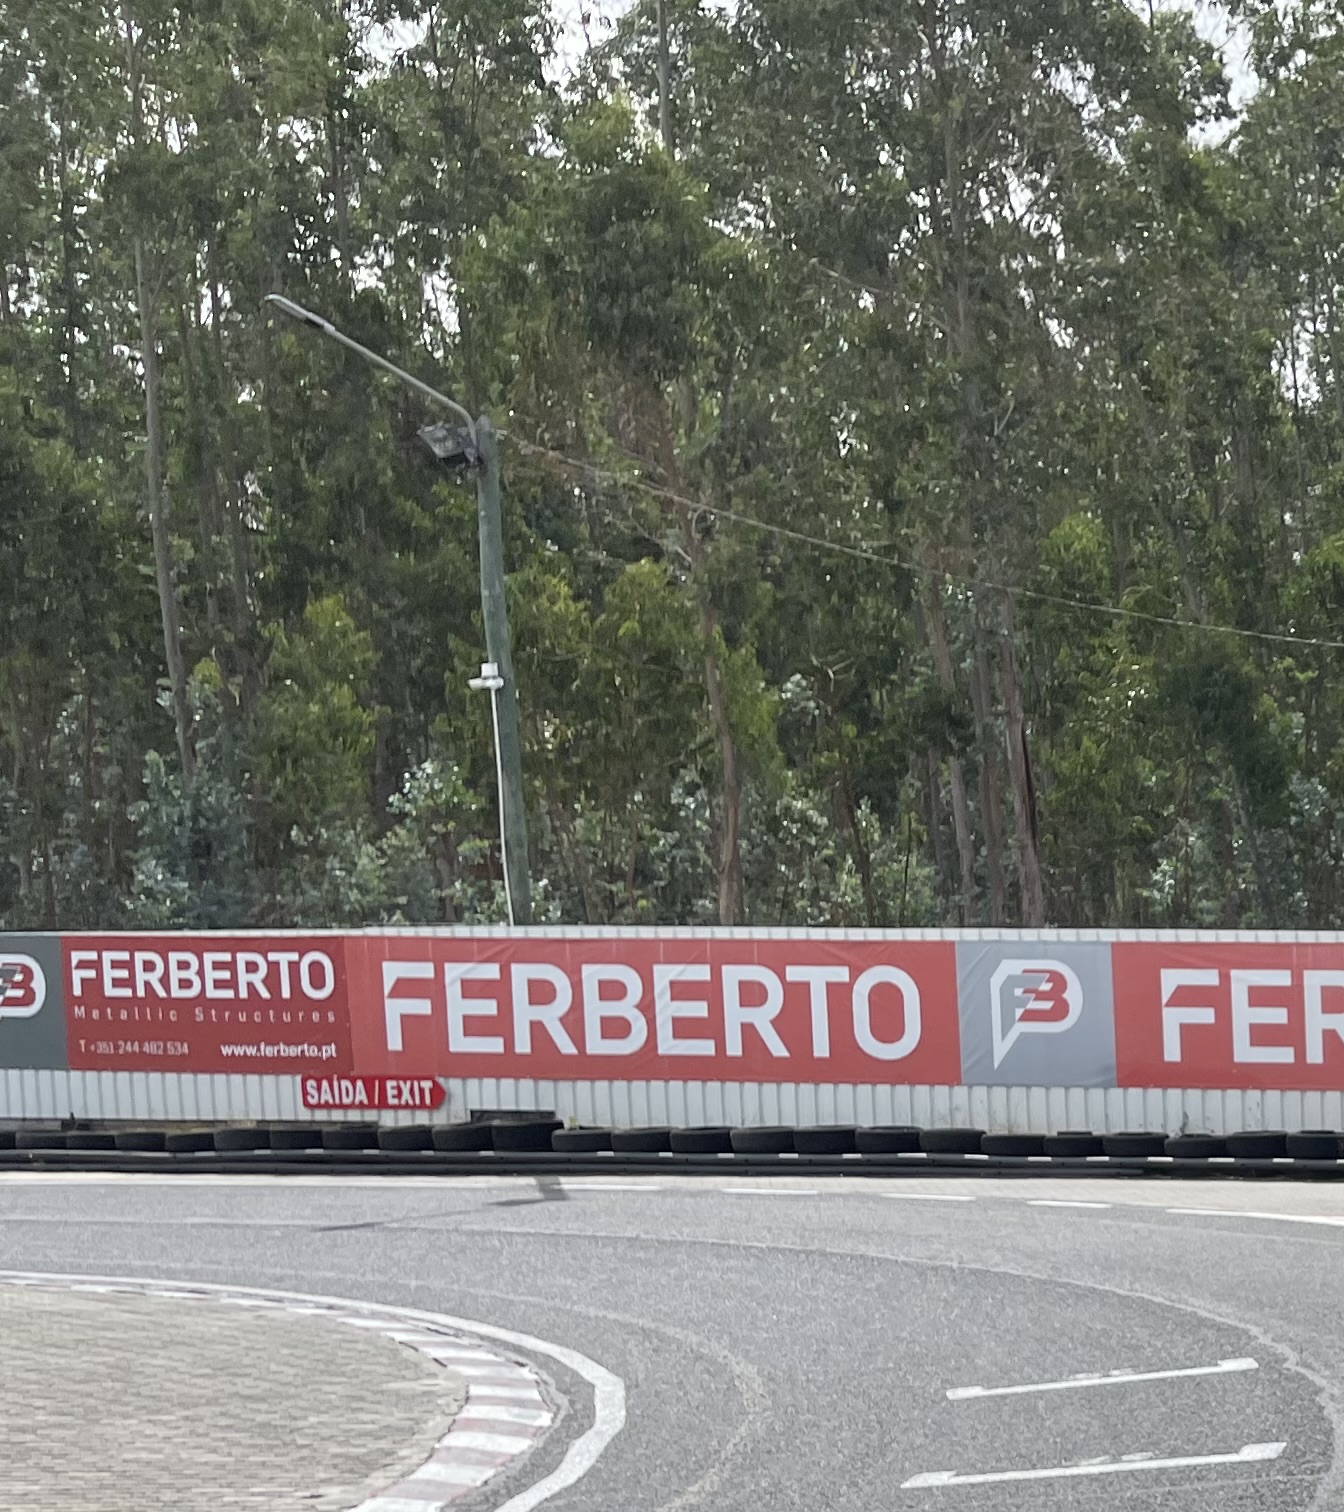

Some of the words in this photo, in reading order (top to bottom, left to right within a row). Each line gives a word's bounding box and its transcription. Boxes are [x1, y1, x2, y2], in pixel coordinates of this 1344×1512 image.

[70, 949, 335, 1000] FERBERTO
[74, 1005, 178, 1022] Metallic
[194, 1006, 336, 1023] Structures
[382, 960, 922, 1060] FERBERTO
[220, 1040, 337, 1060] www.ferberto.pt
[306, 1073, 369, 1106] SAÍDA
[386, 1079, 433, 1106] EXIT
